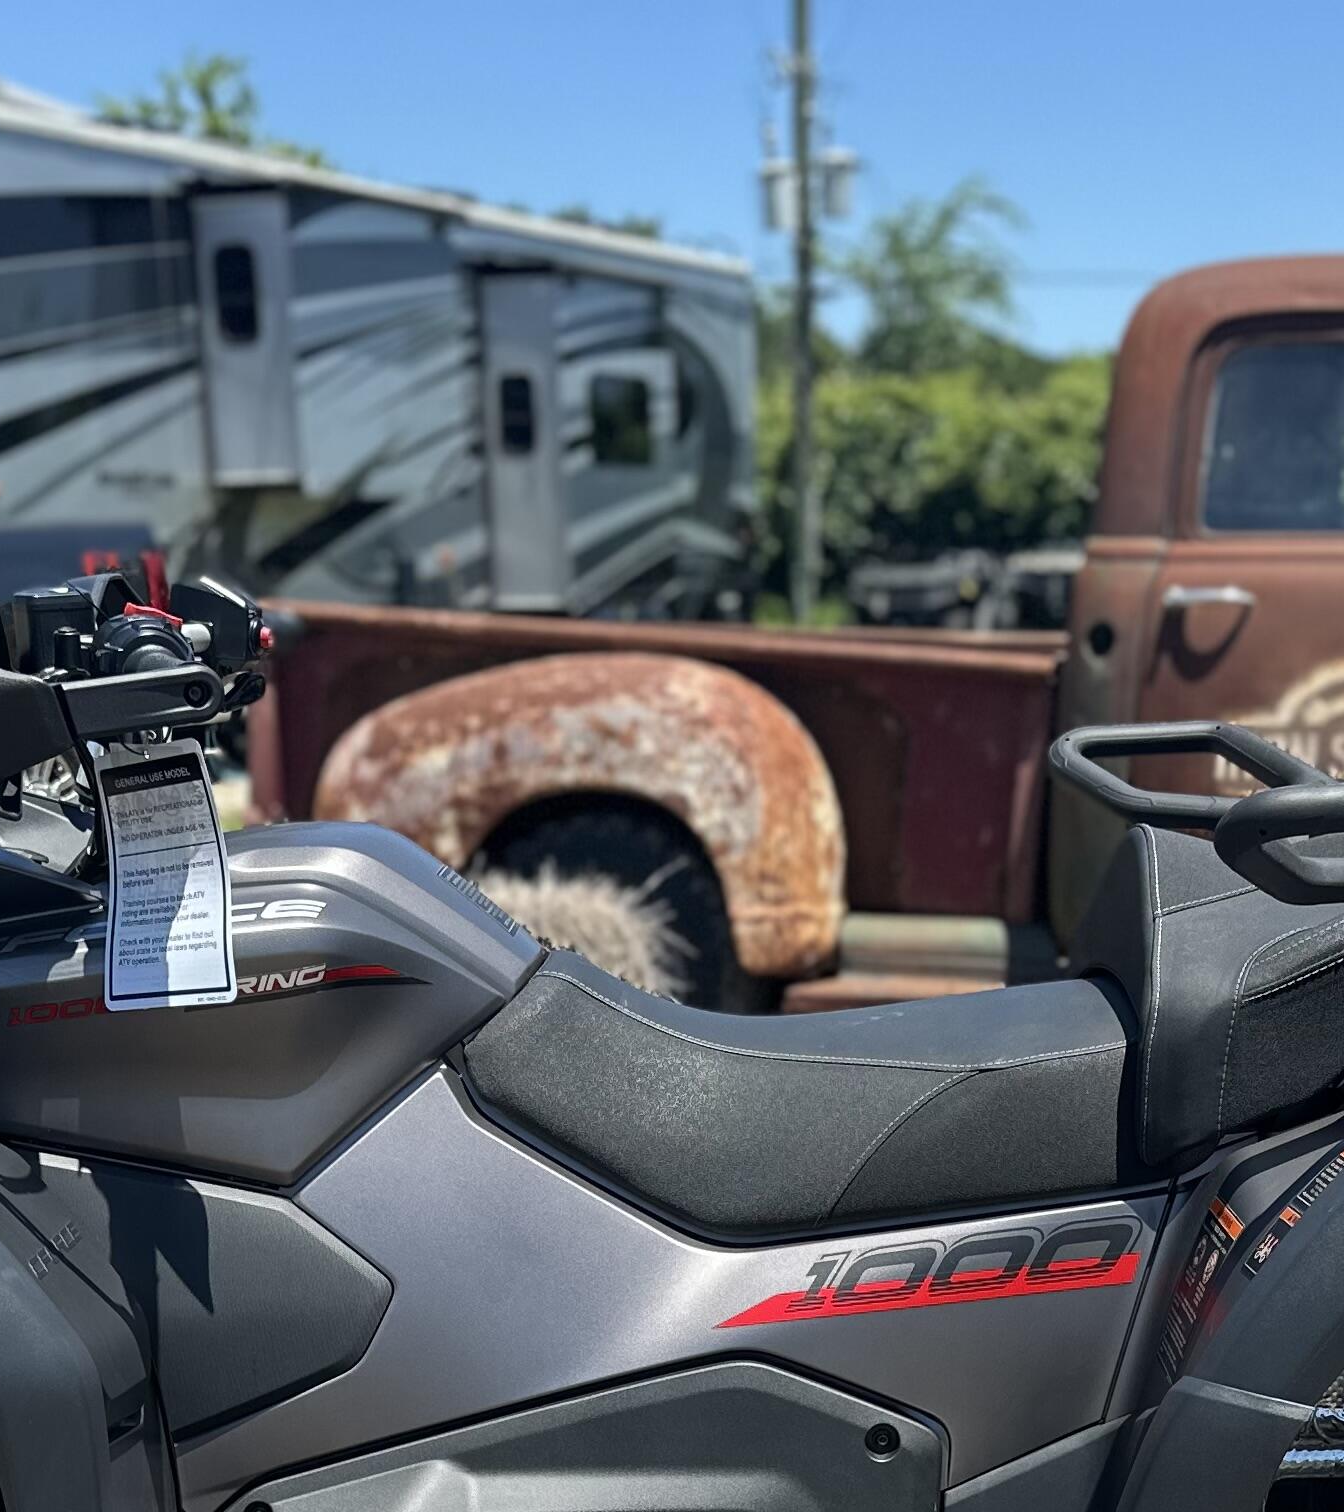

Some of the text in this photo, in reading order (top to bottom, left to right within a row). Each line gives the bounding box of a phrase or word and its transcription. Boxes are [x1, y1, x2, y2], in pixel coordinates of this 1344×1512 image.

[115, 766, 190, 788] GENERAL USE MODEL
[119, 938, 137, 947] Check
[152, 936, 165, 946] your
[119, 948, 135, 957] about
[7, 997, 107, 1029] 100
[789, 1215, 1143, 1313] 1000
